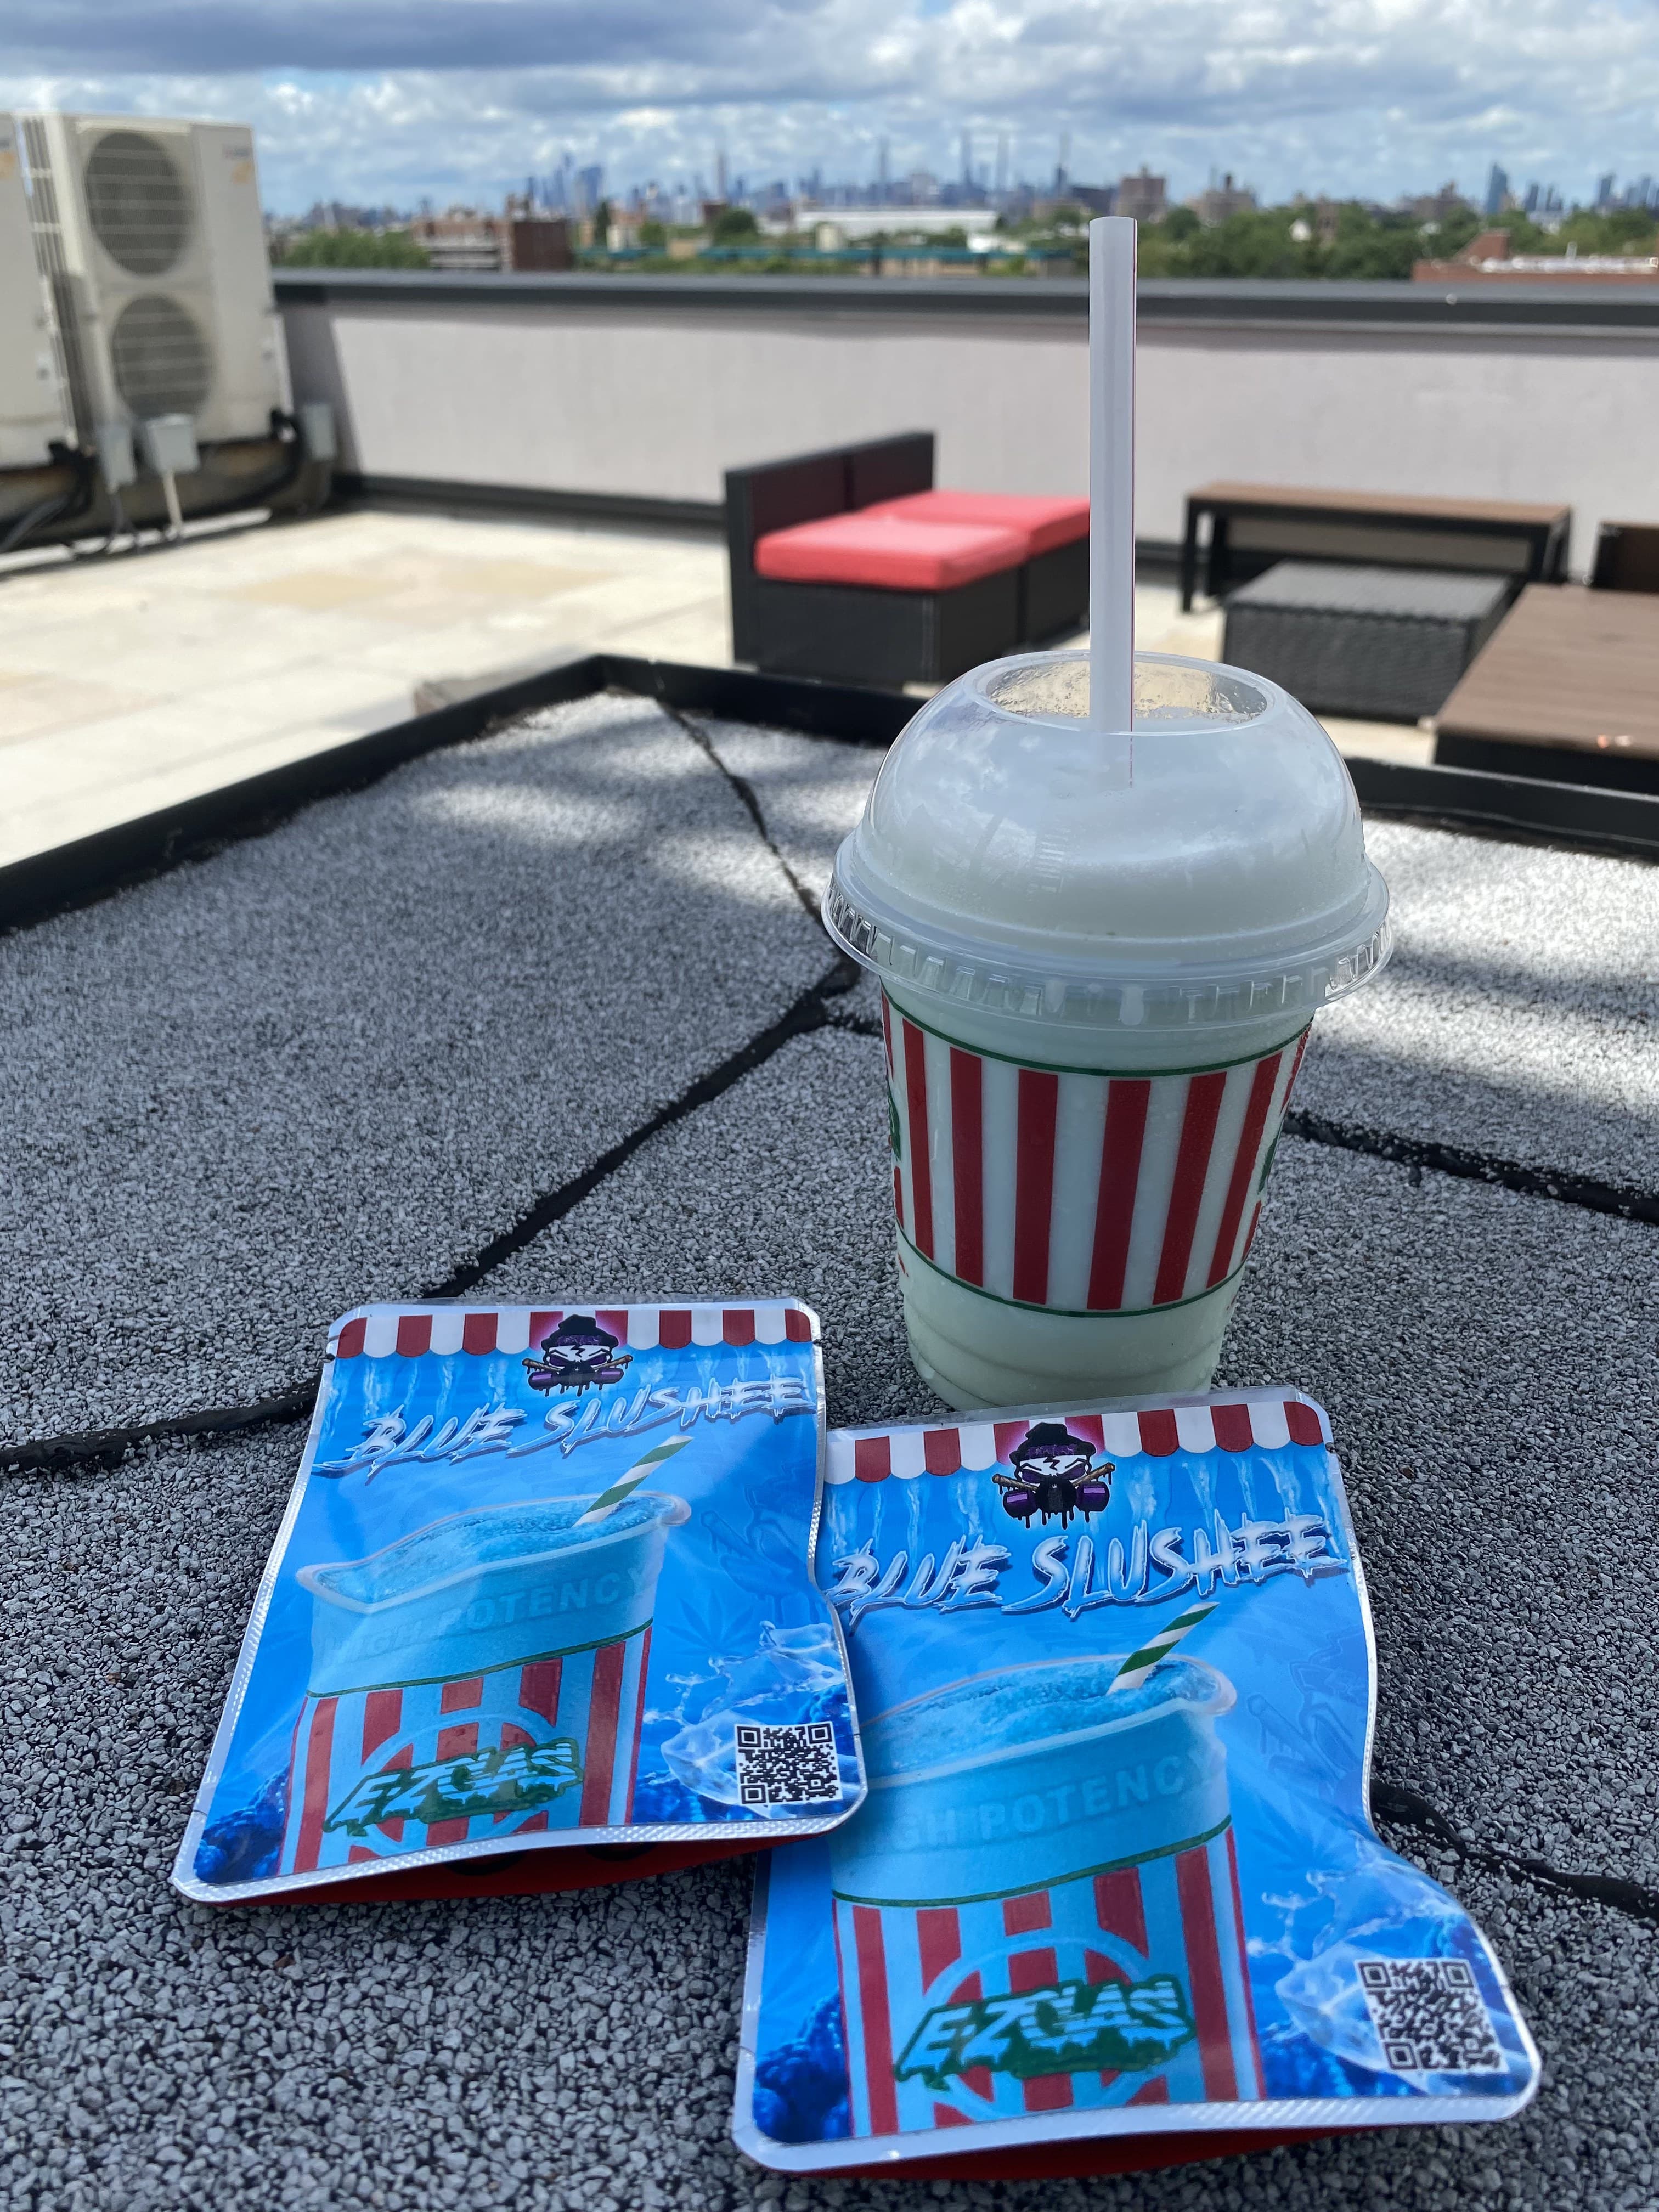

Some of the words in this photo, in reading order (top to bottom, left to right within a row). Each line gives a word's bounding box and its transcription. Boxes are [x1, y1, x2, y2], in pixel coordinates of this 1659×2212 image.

[311, 1402, 527, 1477] BLUE
[506, 1373, 816, 1455] SLUSHEE
[824, 1535, 1011, 1626] BLUE
[1001, 1507, 1347, 1617] SLUSHEE
